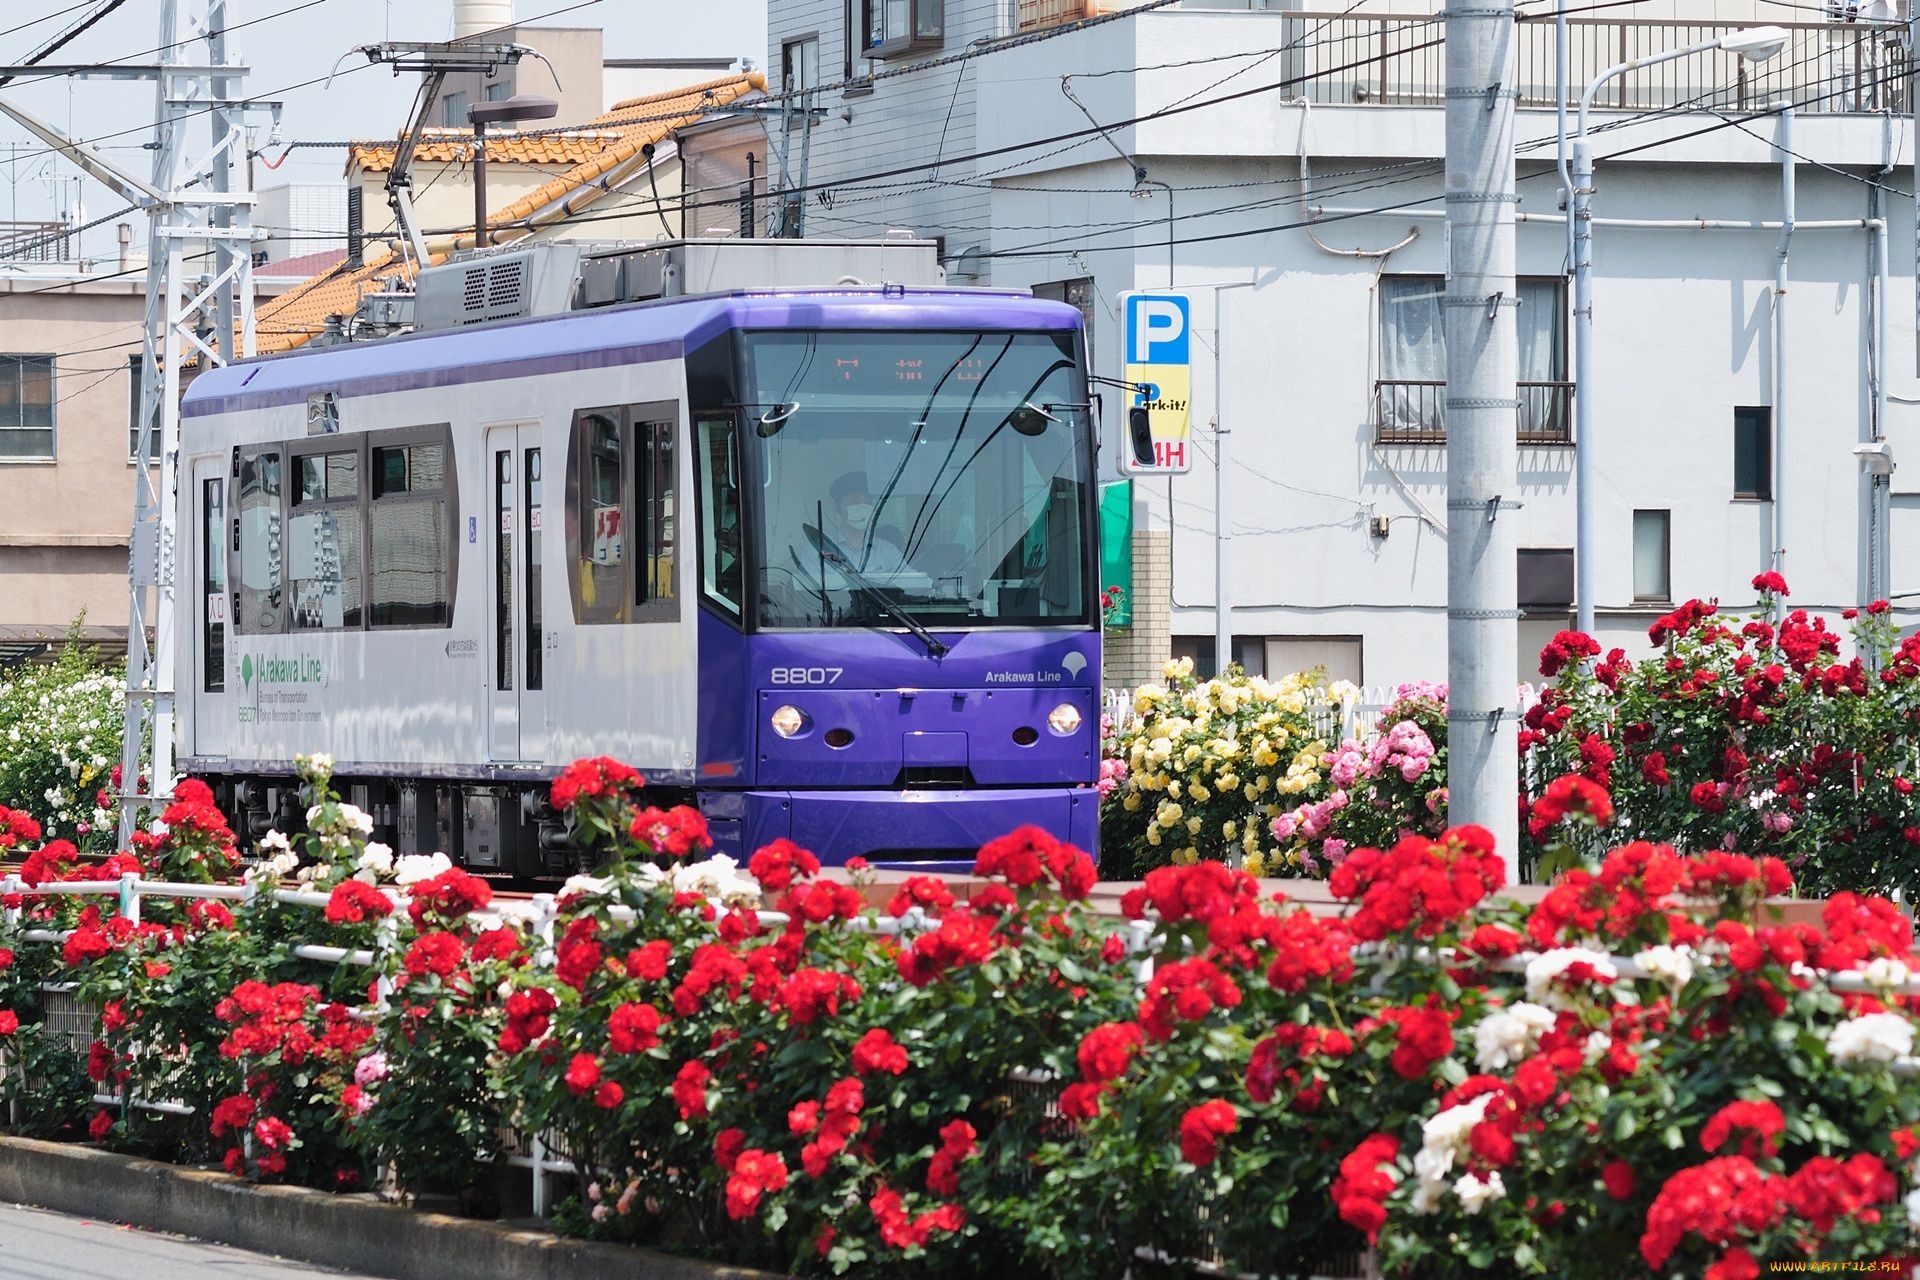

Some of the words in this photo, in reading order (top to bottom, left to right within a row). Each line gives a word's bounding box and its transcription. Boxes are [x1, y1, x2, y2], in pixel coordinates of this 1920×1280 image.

[1136, 300, 1184, 362] P
[1132, 442, 1184, 467] 4H
[210, 596, 223, 619] 入口
[259, 652, 298, 682] Arakawa
[301, 652, 321, 682] Line
[771, 667, 844, 685] 8807
[985, 671, 1034, 682] Arakawa
[1037, 671, 1061, 682] Line
[239, 706, 256, 722] 8807
